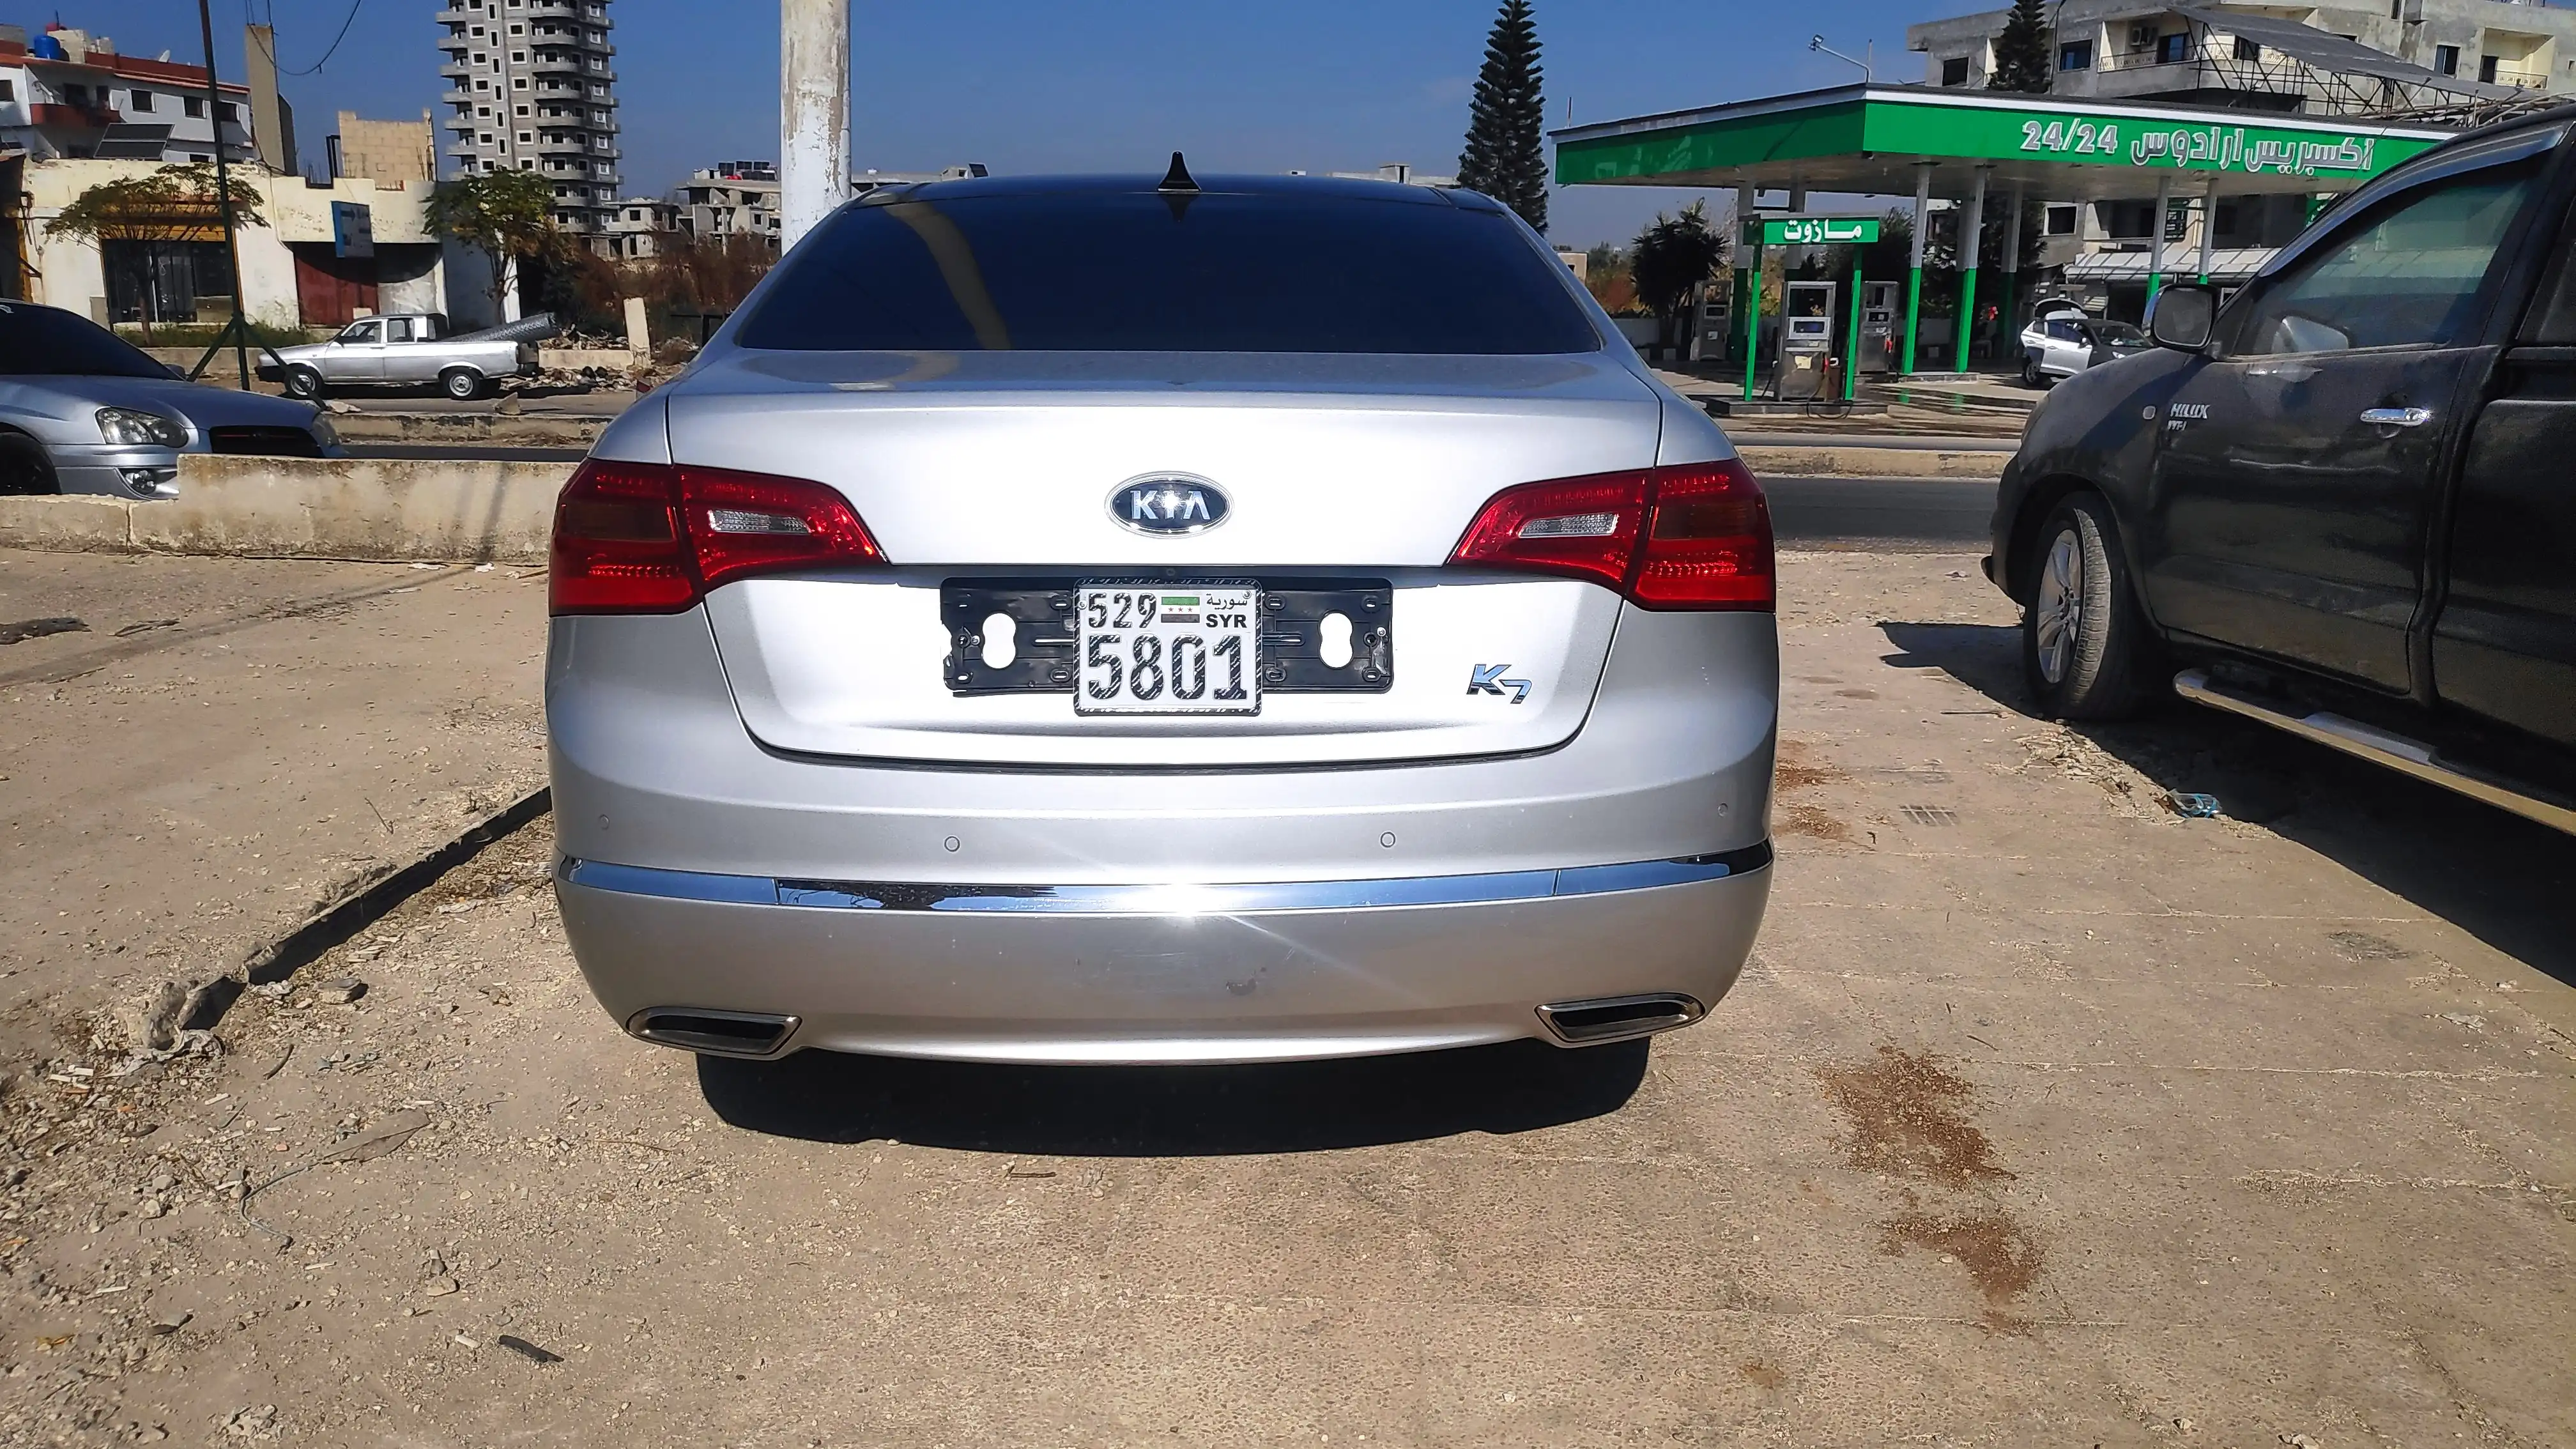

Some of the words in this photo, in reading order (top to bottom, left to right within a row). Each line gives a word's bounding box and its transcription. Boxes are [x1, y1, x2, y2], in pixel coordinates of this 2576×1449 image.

[2020, 118, 2119, 154] 24/24
[1784, 219, 1862, 243] مازوت
[2170, 403, 2211, 419] HILUX
[1130, 489, 1211, 520] KIA
[1088, 592, 1157, 629] 529
[1206, 594, 1248, 610] سورية
[1206, 614, 1248, 629] SYR
[1088, 634, 1248, 701] 5801
[1466, 663, 1533, 705] K7
